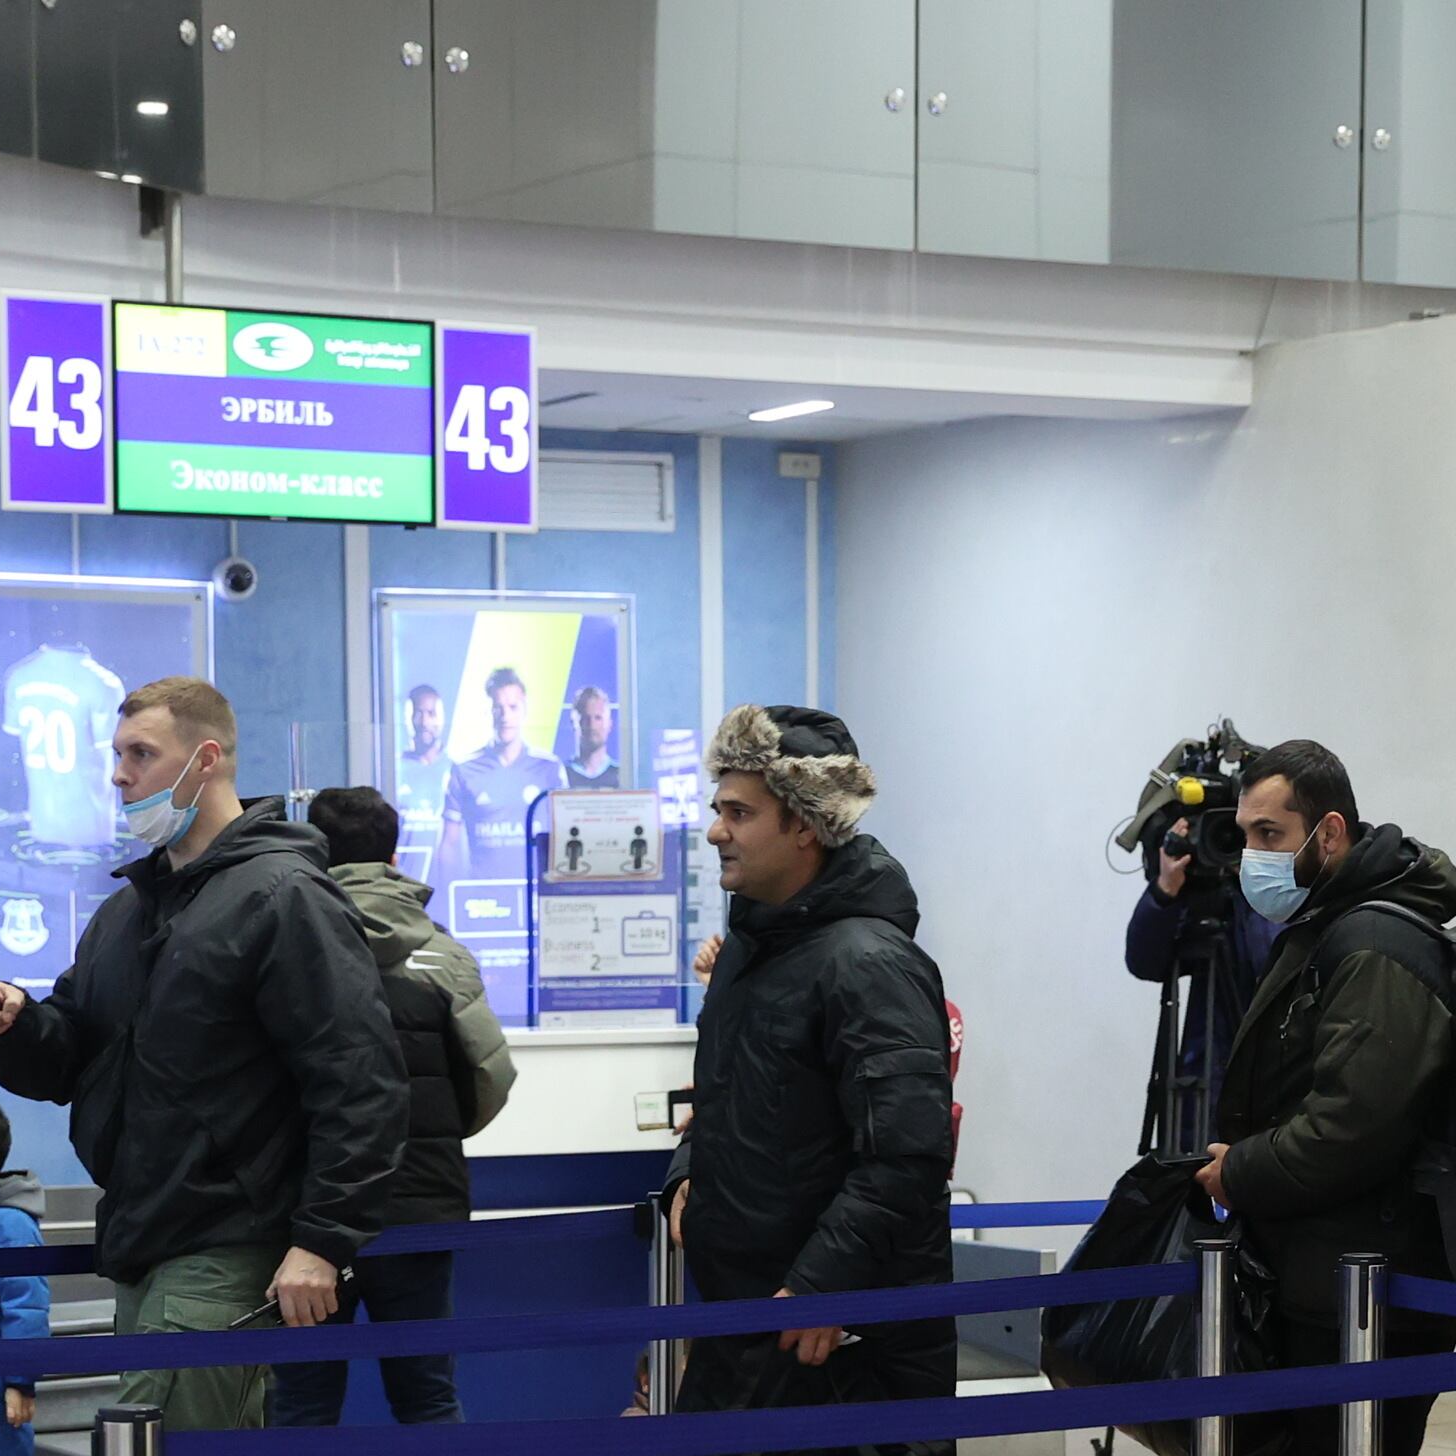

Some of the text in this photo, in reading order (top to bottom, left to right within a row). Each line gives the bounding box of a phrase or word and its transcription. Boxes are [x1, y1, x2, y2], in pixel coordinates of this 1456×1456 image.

[8, 355, 104, 450] 43
[220, 396, 334, 427] ЭРБИЛЬ
[444, 384, 530, 473] 43
[169, 459, 384, 498] Эконом-класс
[18, 705, 76, 774] 20
